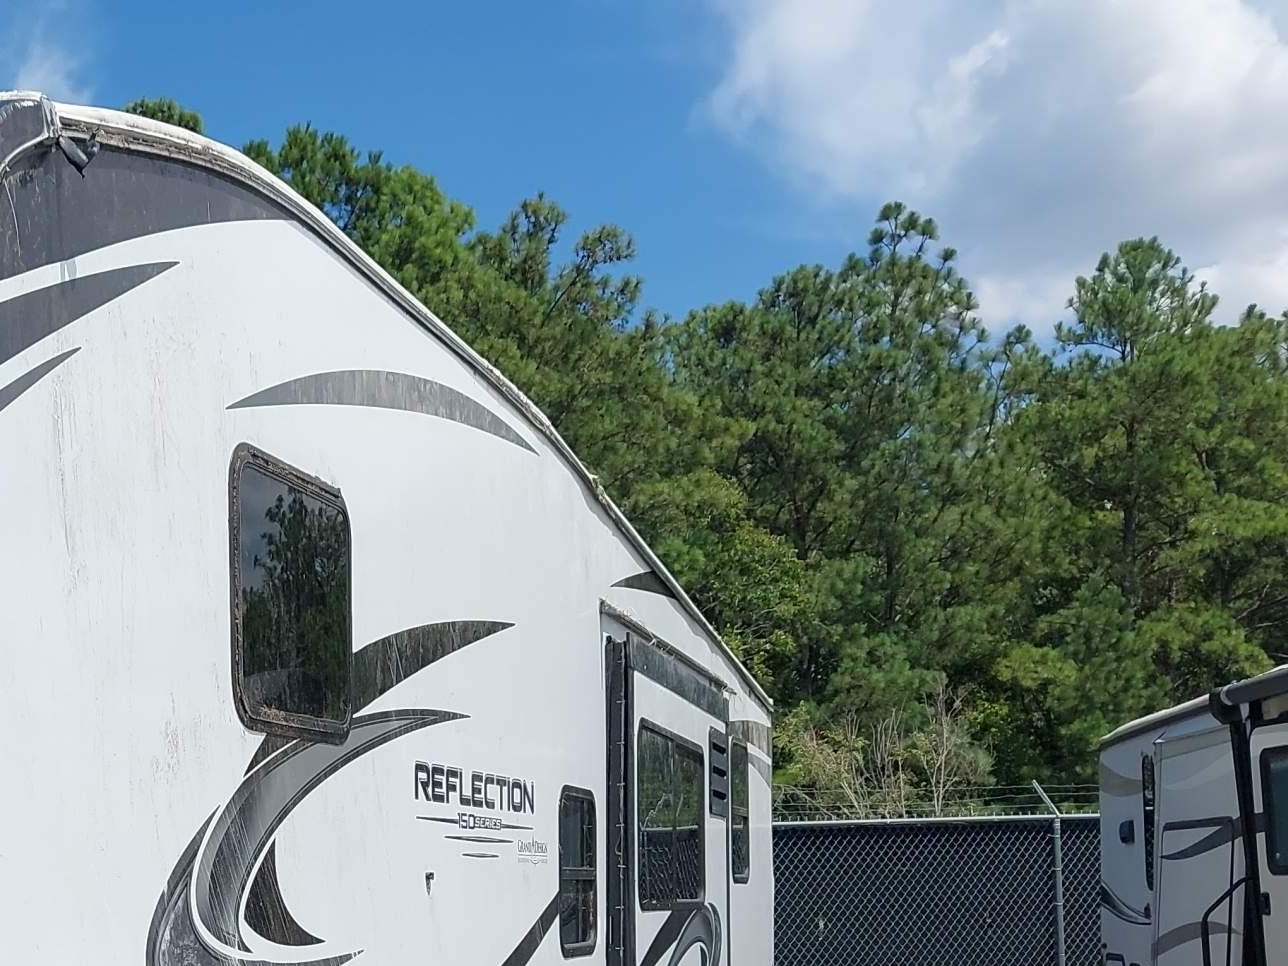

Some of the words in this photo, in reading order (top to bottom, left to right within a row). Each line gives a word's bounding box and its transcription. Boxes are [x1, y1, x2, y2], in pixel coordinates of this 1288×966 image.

[414, 760, 535, 815] REFLECTION
[457, 812, 475, 830] 150
[475, 815, 502, 831] SERIES
